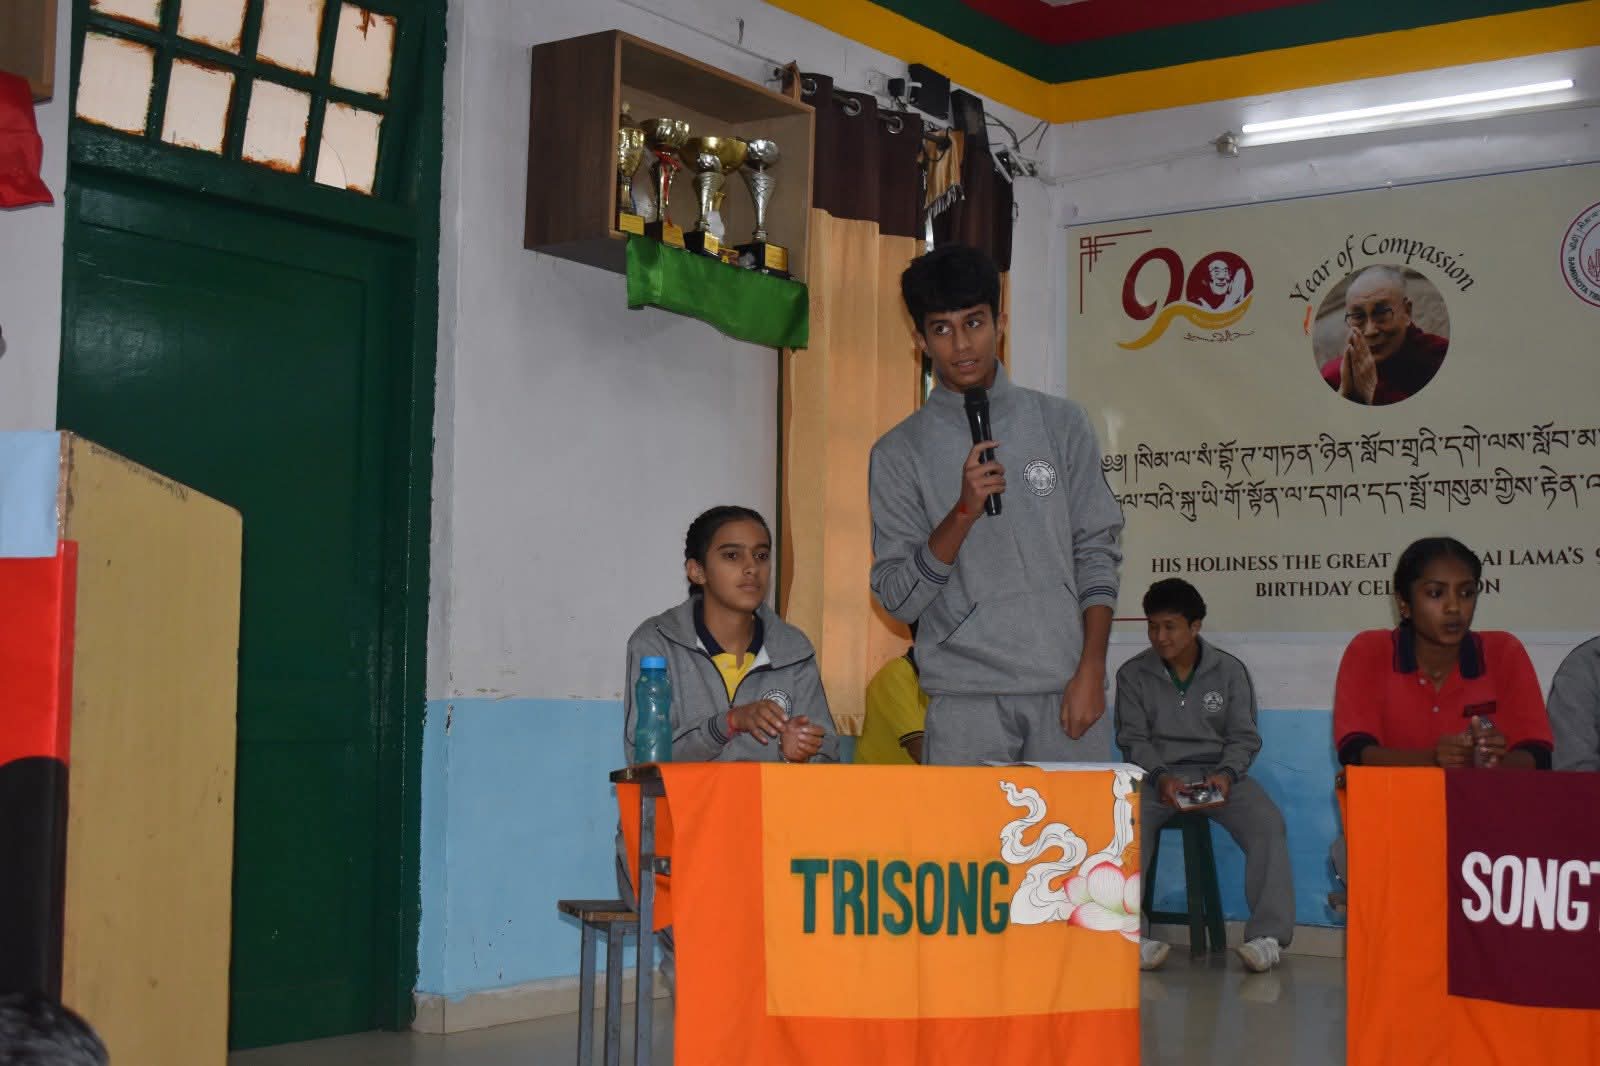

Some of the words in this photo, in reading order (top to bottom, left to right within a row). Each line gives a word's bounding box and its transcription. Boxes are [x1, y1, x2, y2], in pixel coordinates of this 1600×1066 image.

[1289, 259, 1330, 303] Year
[1336, 234, 1354, 277] of
[1361, 233, 1475, 292] Compassion
[1151, 557, 1182, 573] HIS
[1186, 555, 1279, 572] HOLINESS
[1282, 554, 1322, 570] THE
[1326, 553, 1392, 569] GREAT
[1509, 546, 1585, 566] LAMA'S
[1255, 581, 1353, 597] BIRTHDAY
[791, 858, 1009, 936] TRISONG
